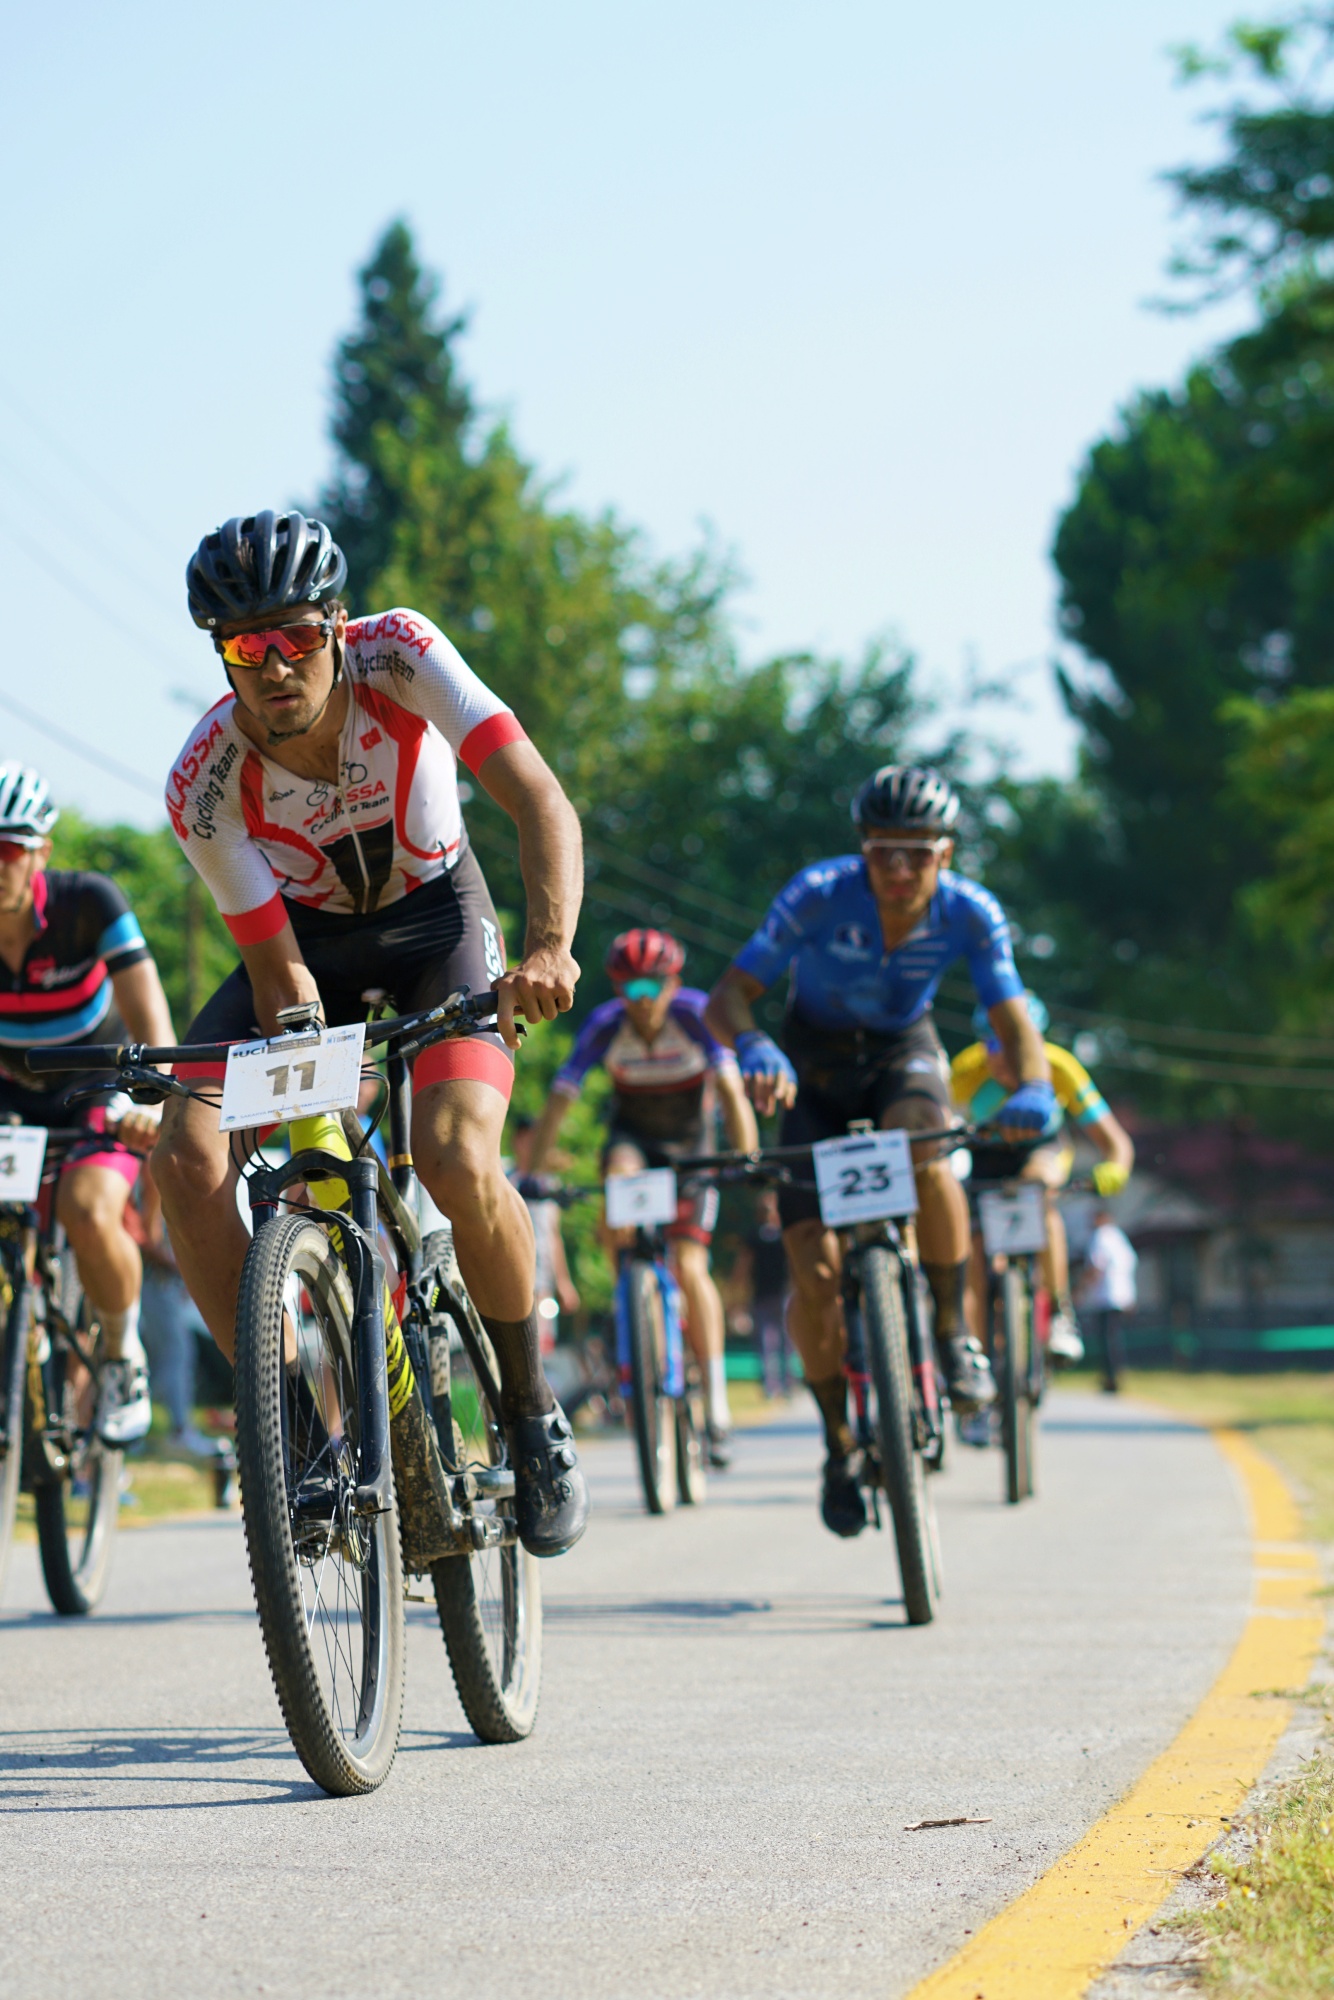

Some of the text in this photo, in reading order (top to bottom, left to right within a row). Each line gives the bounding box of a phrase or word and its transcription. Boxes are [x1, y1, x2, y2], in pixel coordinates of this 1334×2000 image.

[193, 743, 239, 840] Cycling Team
[360, 796, 390, 811] Team
[238, 1047, 266, 1058] UCI
[265, 1059, 317, 1097] 11
[840, 1164, 891, 1197] 23
